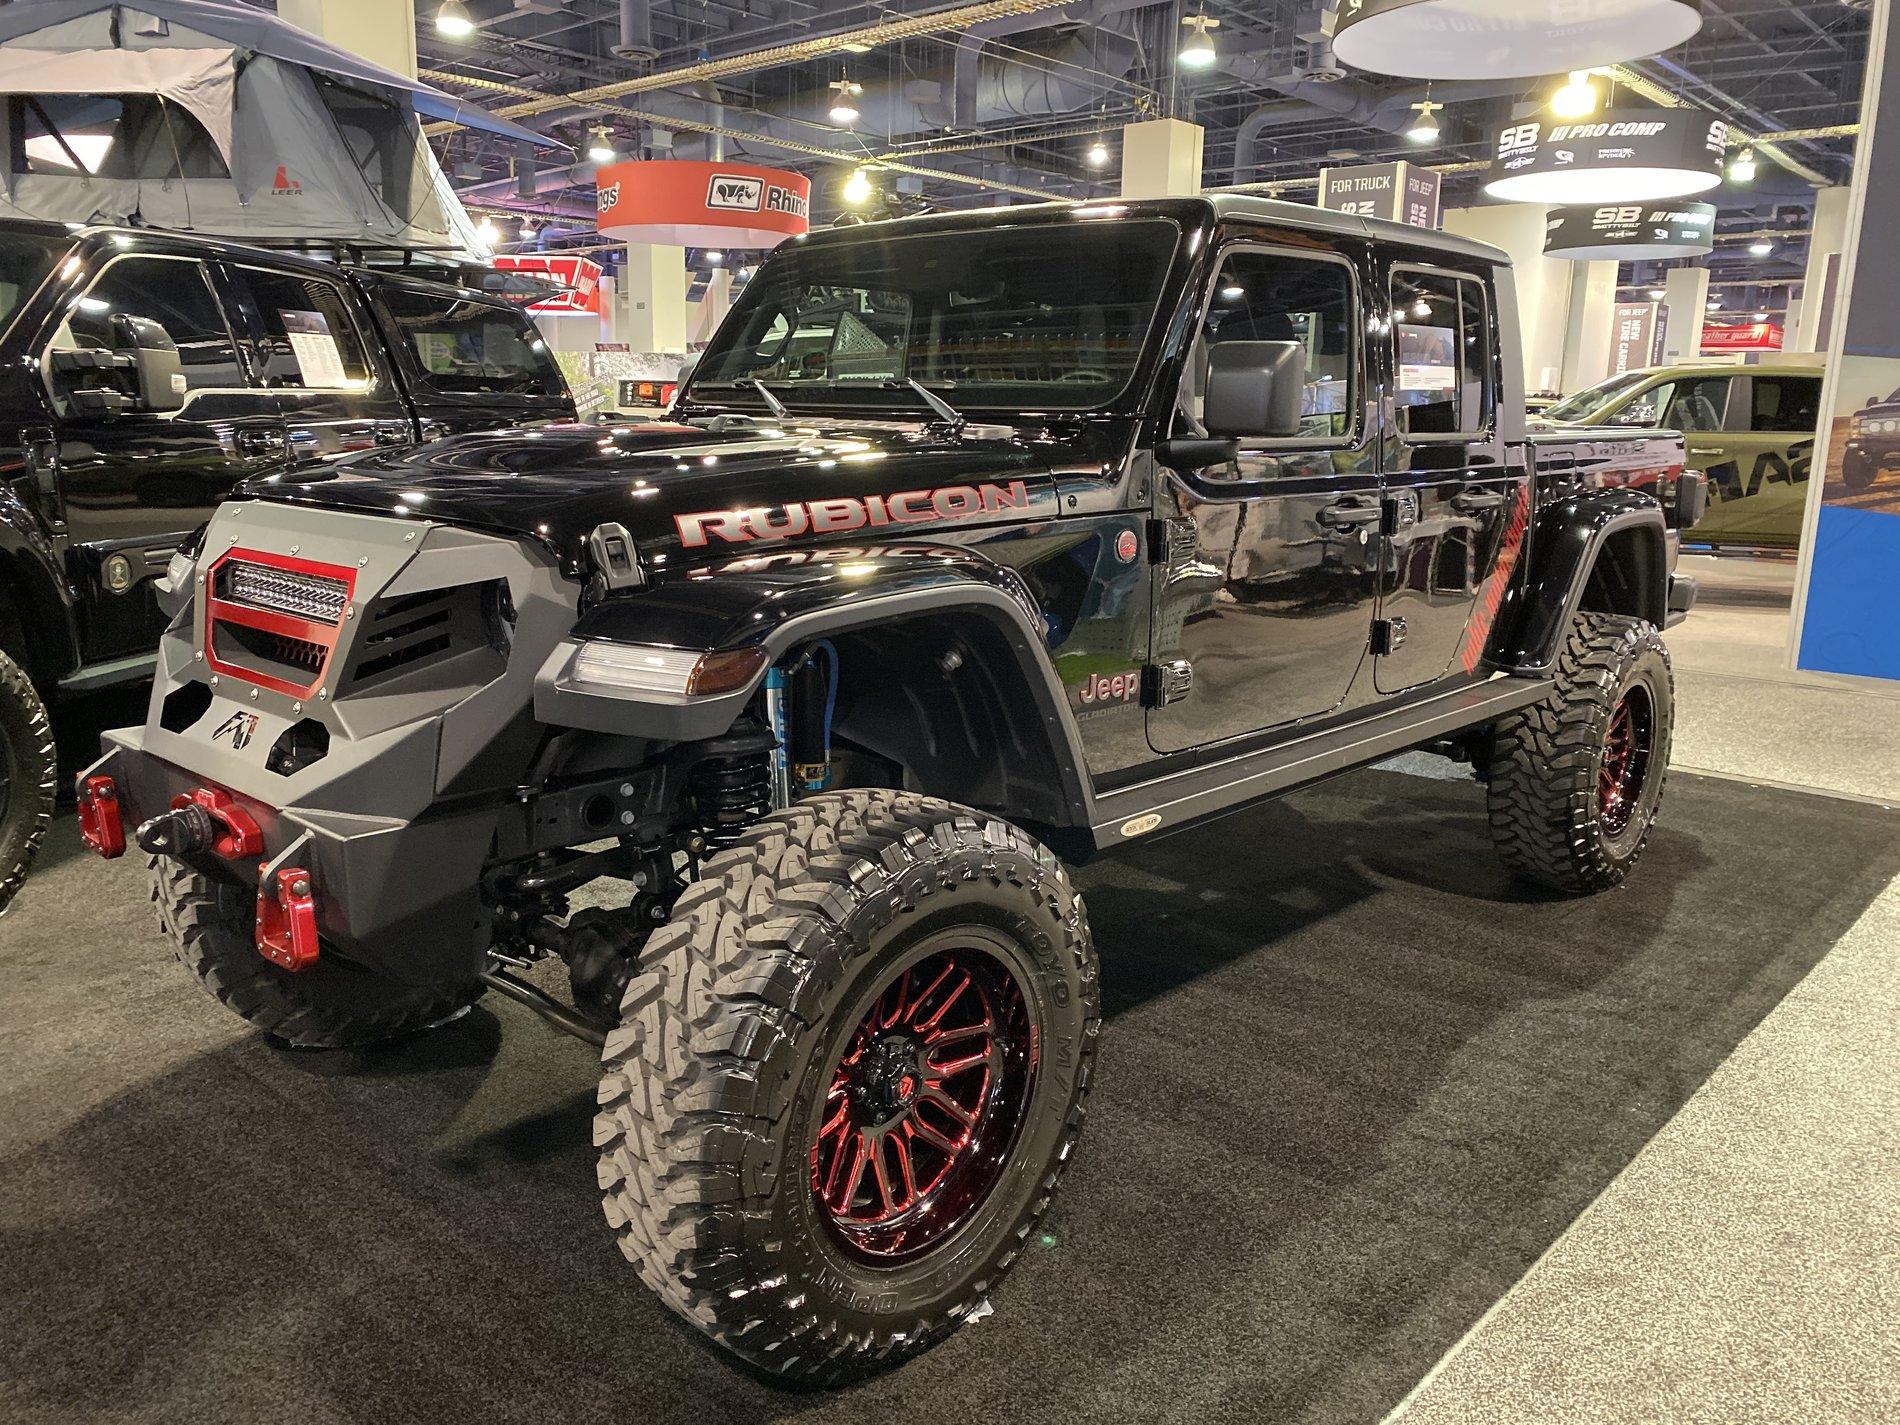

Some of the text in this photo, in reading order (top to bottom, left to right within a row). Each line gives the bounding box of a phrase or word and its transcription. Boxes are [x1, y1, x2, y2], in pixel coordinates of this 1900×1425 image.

[1568, 121, 1666, 139] PRO COMP
[1331, 176, 1391, 193] FOR TRUCK
[765, 185, 807, 218] Rhino
[1592, 206, 1642, 224] SB
[1620, 320, 1632, 342] TIRE
[1631, 319, 1642, 341] NEW
[673, 481, 1029, 548] RUBICON
[1079, 673, 1138, 704] Jeep
[1077, 703, 1140, 722] GLADIATOR
